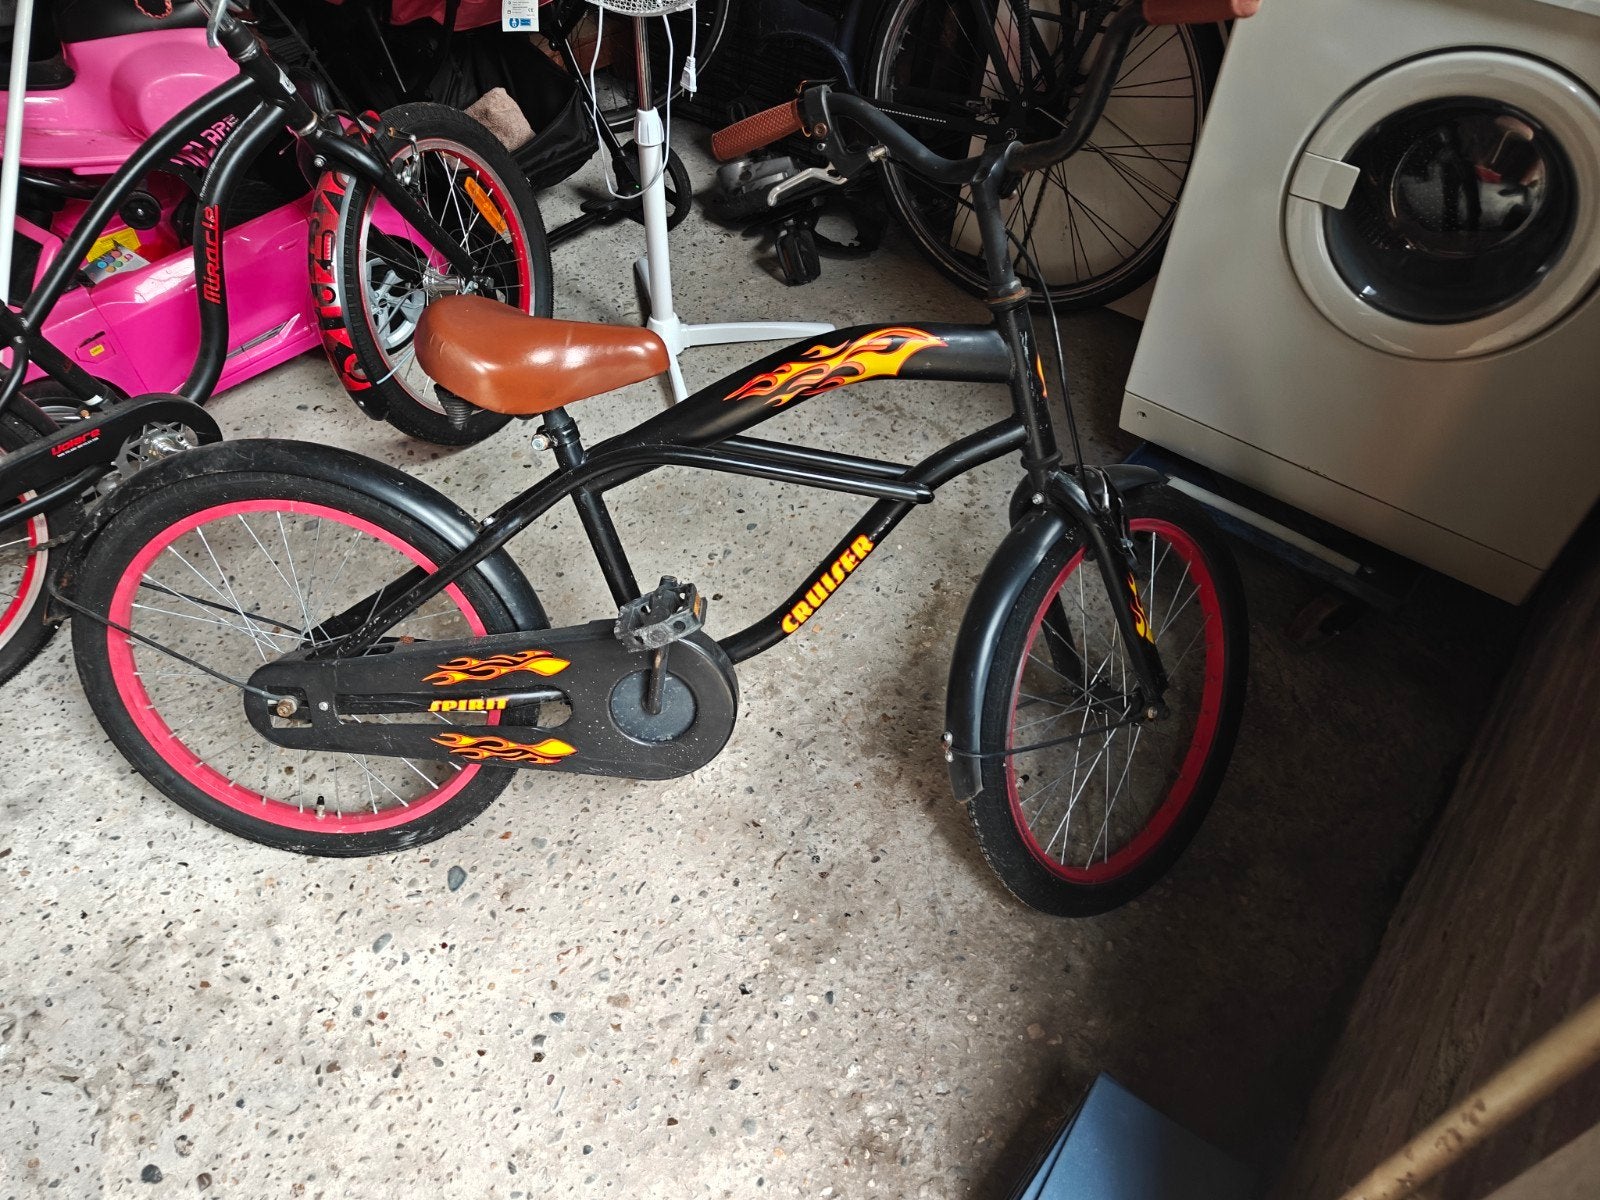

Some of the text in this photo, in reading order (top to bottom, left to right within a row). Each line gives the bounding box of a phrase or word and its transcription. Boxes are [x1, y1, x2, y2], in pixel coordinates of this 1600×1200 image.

[202, 203, 221, 305] Miracle
[781, 534, 875, 634] CRUISER
[427, 697, 510, 713] SPIRIT
